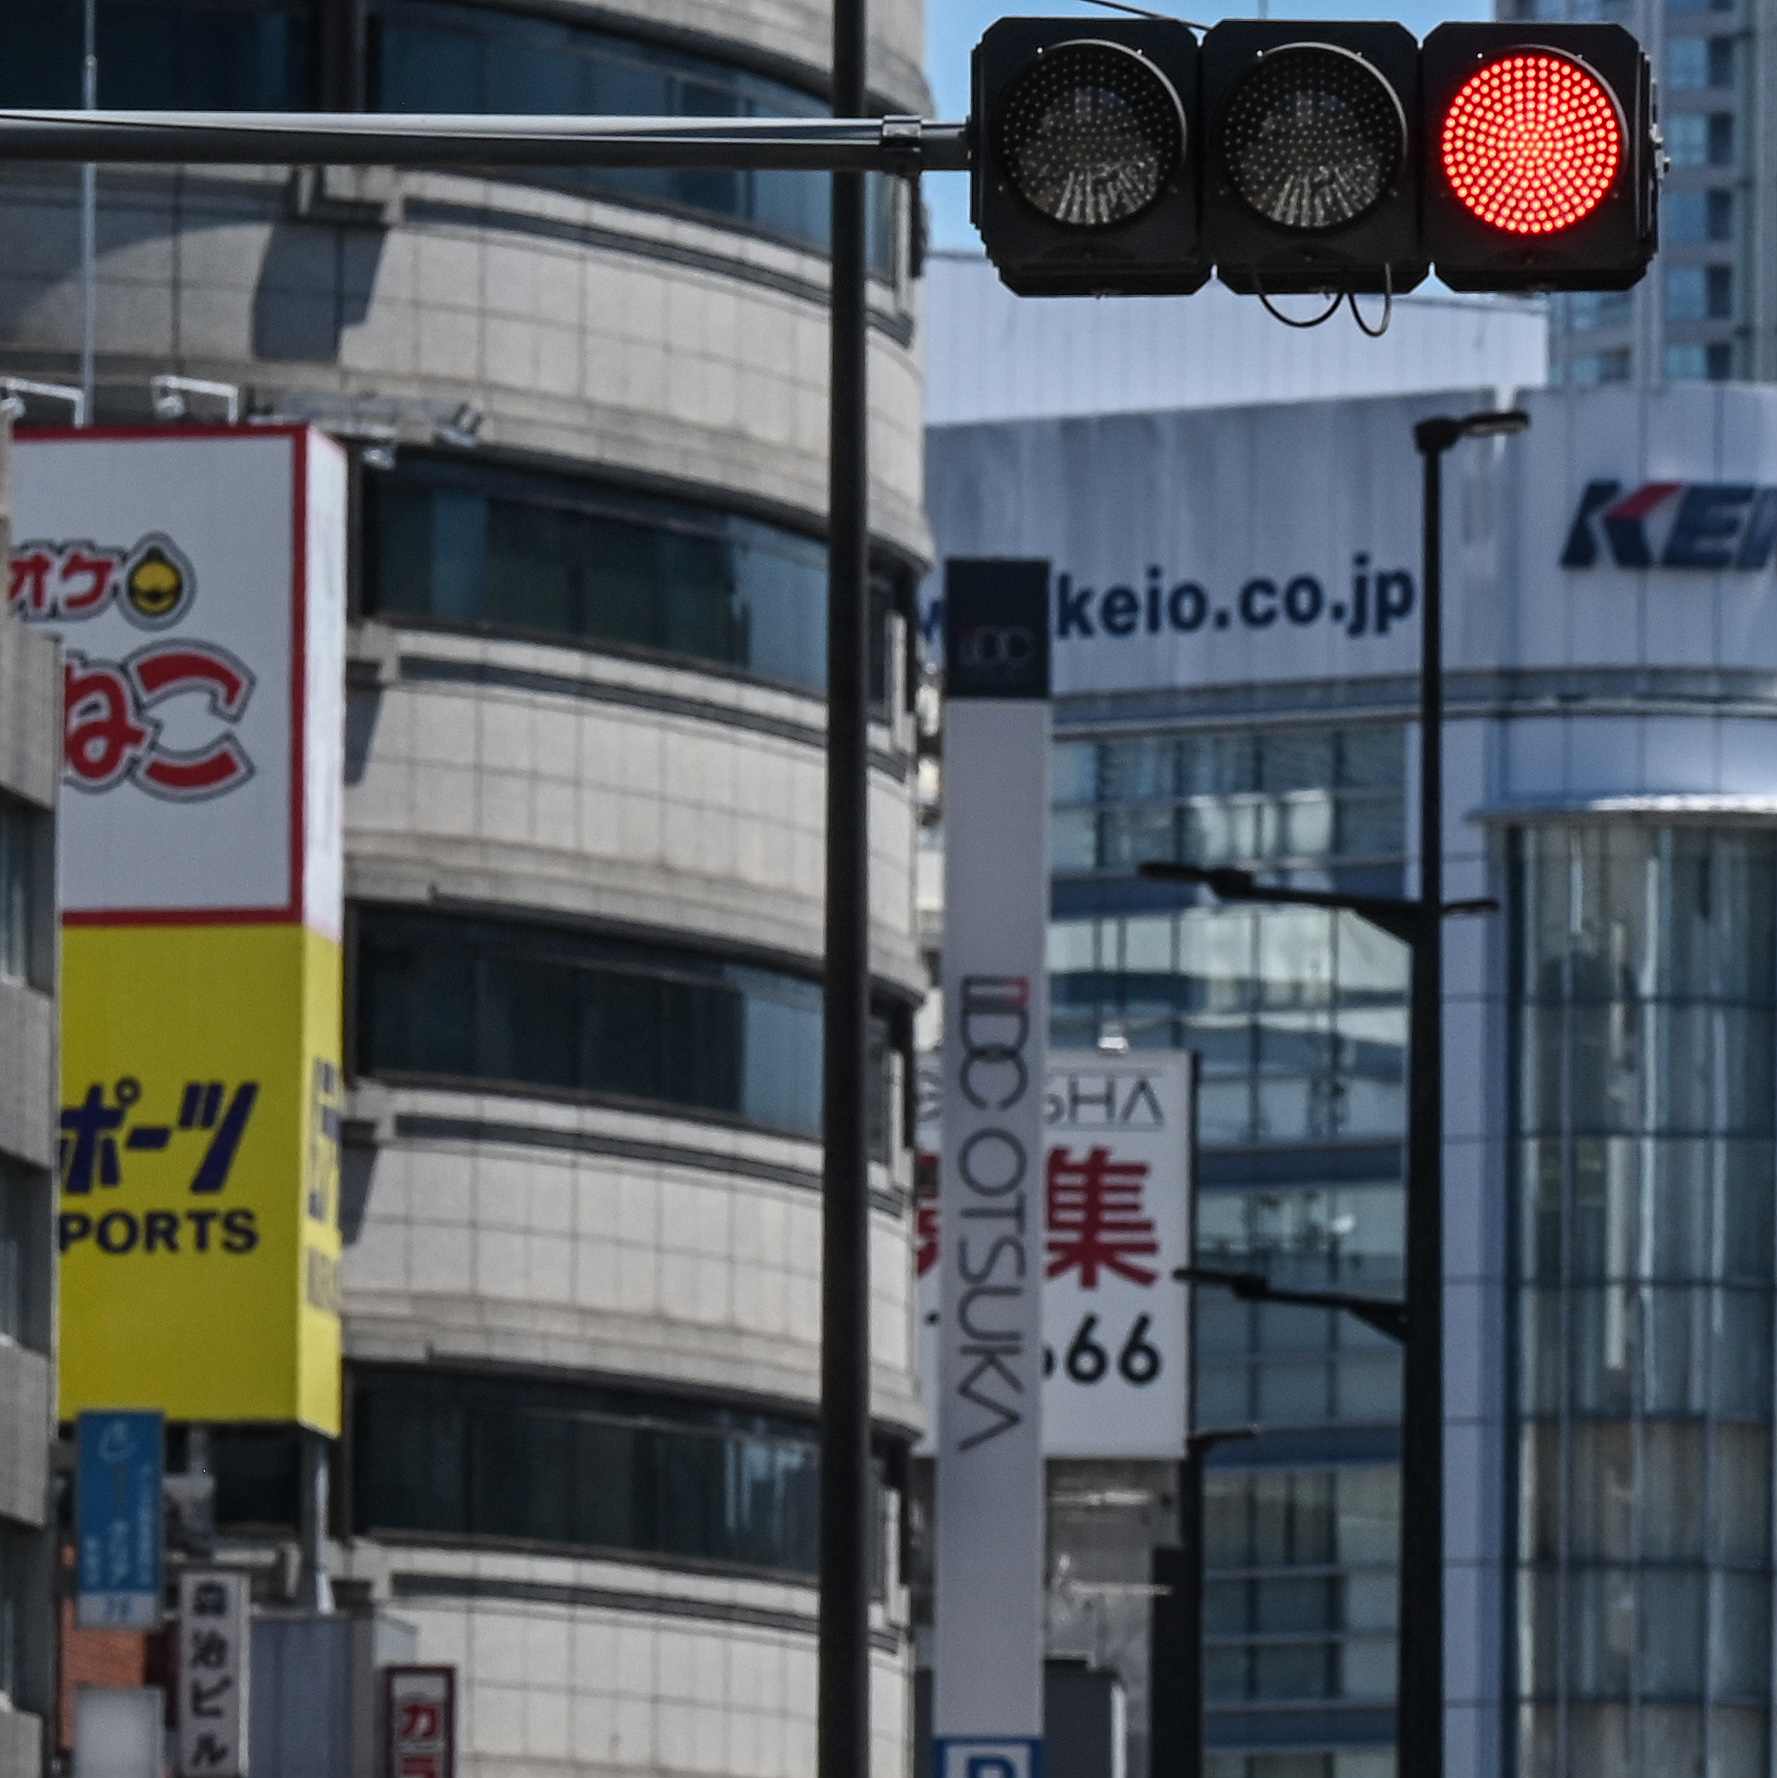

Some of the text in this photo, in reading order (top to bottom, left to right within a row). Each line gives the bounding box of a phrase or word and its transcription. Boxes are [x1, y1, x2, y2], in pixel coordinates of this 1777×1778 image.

[8, 552, 116, 612] オケ
[64, 650, 242, 788] ねこ
[60, 1077, 259, 1194] ポーツ
[60, 1208, 259, 1254] PORTS
[1044, 1144, 1161, 1289] 集
[956, 1127, 1028, 1452] OTSUKA
